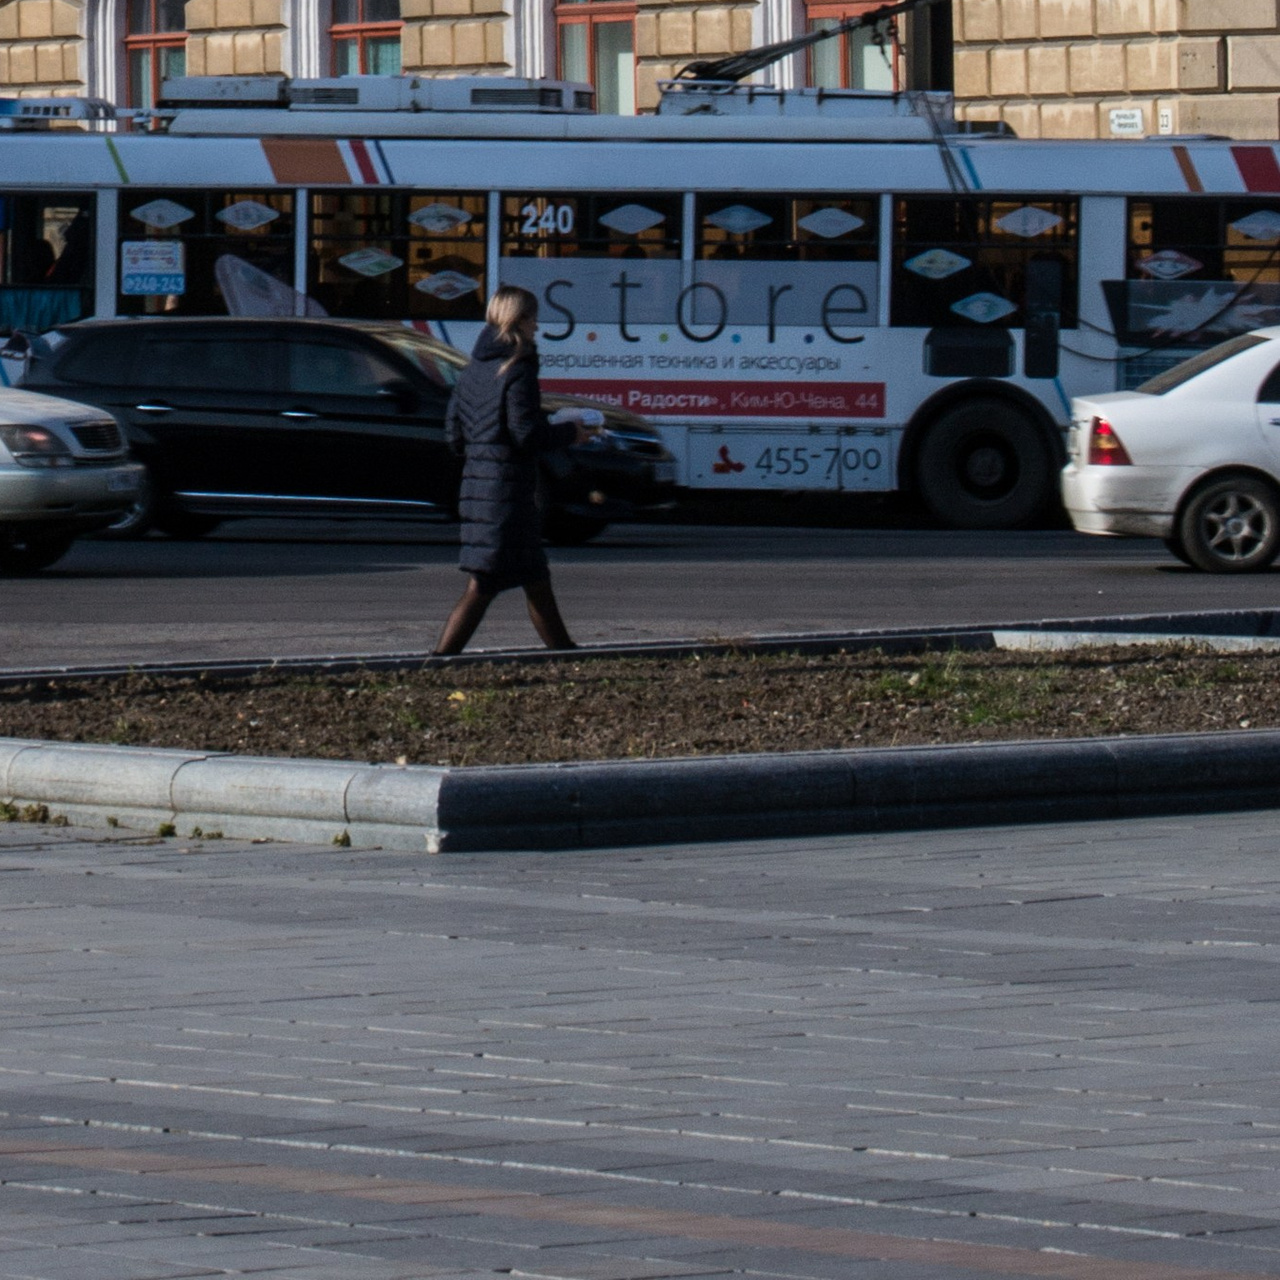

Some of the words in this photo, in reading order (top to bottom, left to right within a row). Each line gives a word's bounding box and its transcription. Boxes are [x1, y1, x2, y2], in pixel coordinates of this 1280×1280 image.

[520, 205, 574, 234] 240
[538, 352, 644, 371] овершенная
[649, 354, 718, 370] техника
[723, 355, 735, 370] и
[739, 355, 841, 374] аксессуары
[854, 393, 878, 409] 44
[755, 446, 882, 475] 455-700
